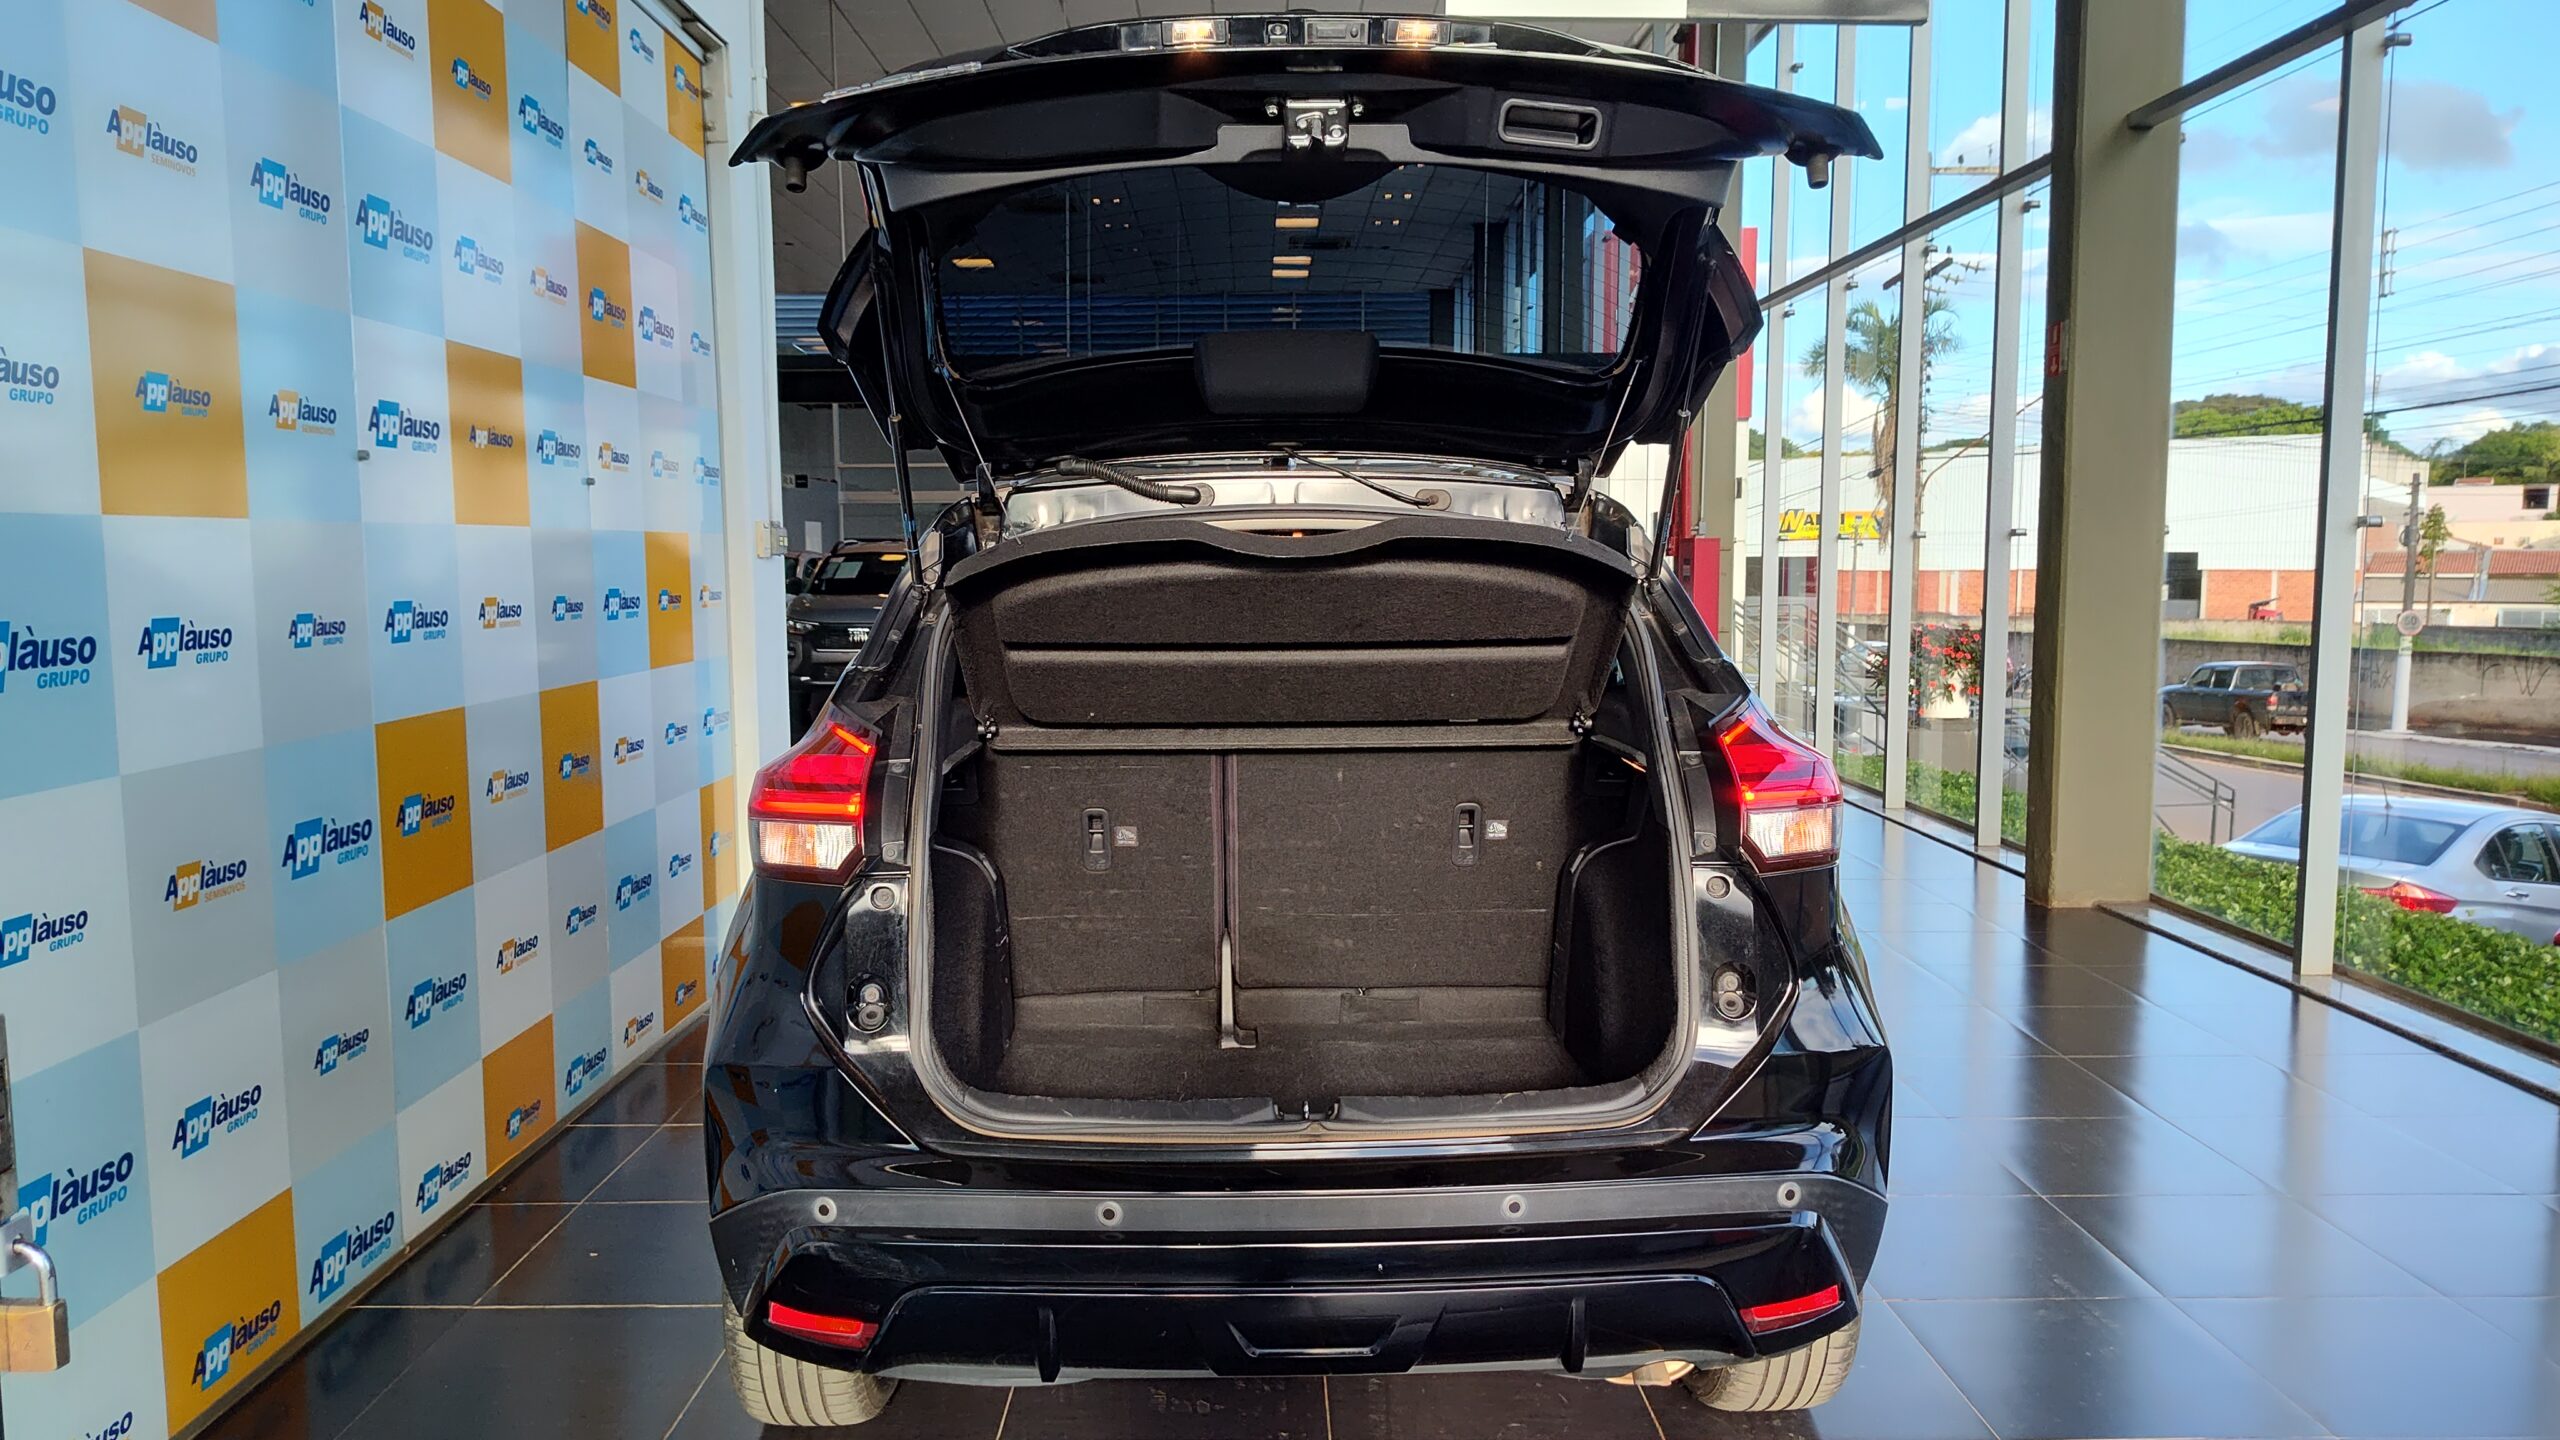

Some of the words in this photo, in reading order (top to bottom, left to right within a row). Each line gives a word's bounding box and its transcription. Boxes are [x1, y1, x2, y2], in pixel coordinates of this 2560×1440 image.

[138, 620, 232, 662] Applàuso
[195, 651, 228, 665] GRUPO
[37, 668, 90, 690] GRUPO
[50, 932, 84, 952] GRUPO
[77, 1186, 128, 1224] GRUPO
